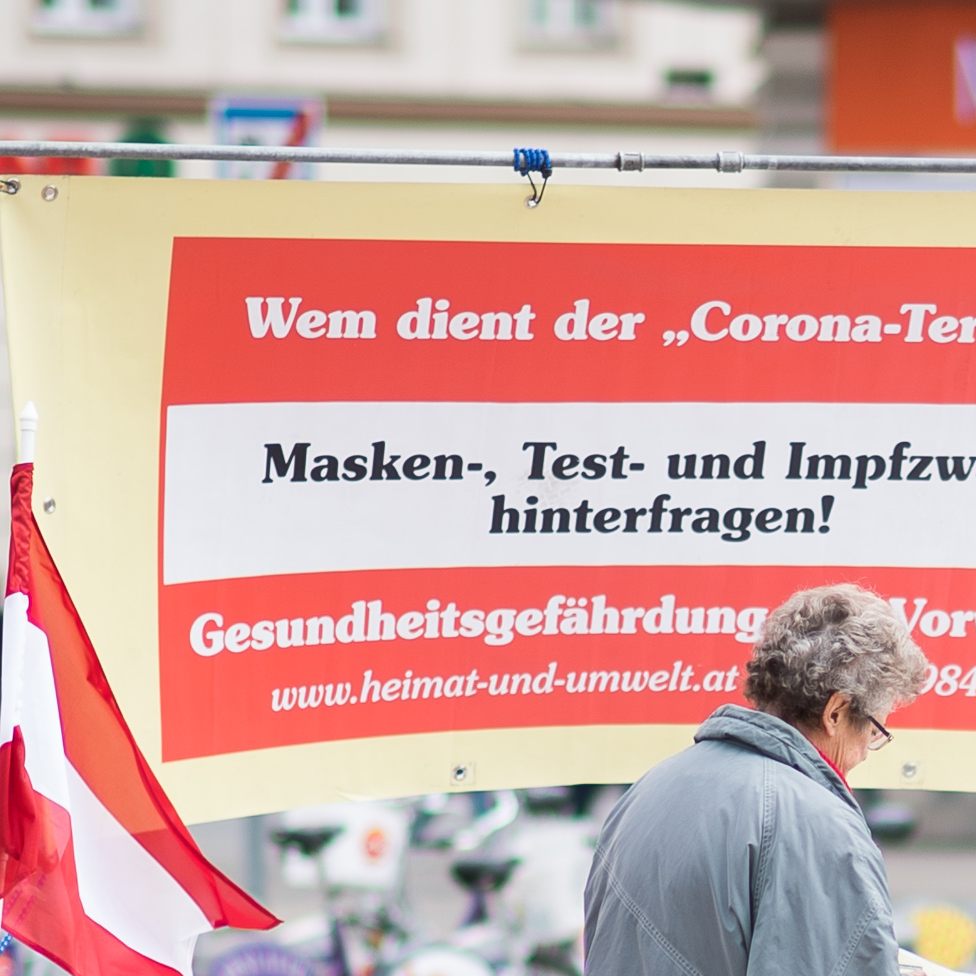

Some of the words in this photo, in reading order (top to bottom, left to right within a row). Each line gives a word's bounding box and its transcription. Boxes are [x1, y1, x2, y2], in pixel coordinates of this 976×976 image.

[245, 296, 377, 340] Wem
[396, 297, 535, 341] dient
[553, 298, 646, 341] der
[261, 440, 498, 487] Masken-,
[521, 441, 646, 481] Test-
[666, 440, 767, 481] und
[488, 493, 836, 542] hinterfragen!
[189, 594, 770, 657] Gesundheitsgefährdung
[271, 660, 740, 712] www.heimat-und-umwelt.at
